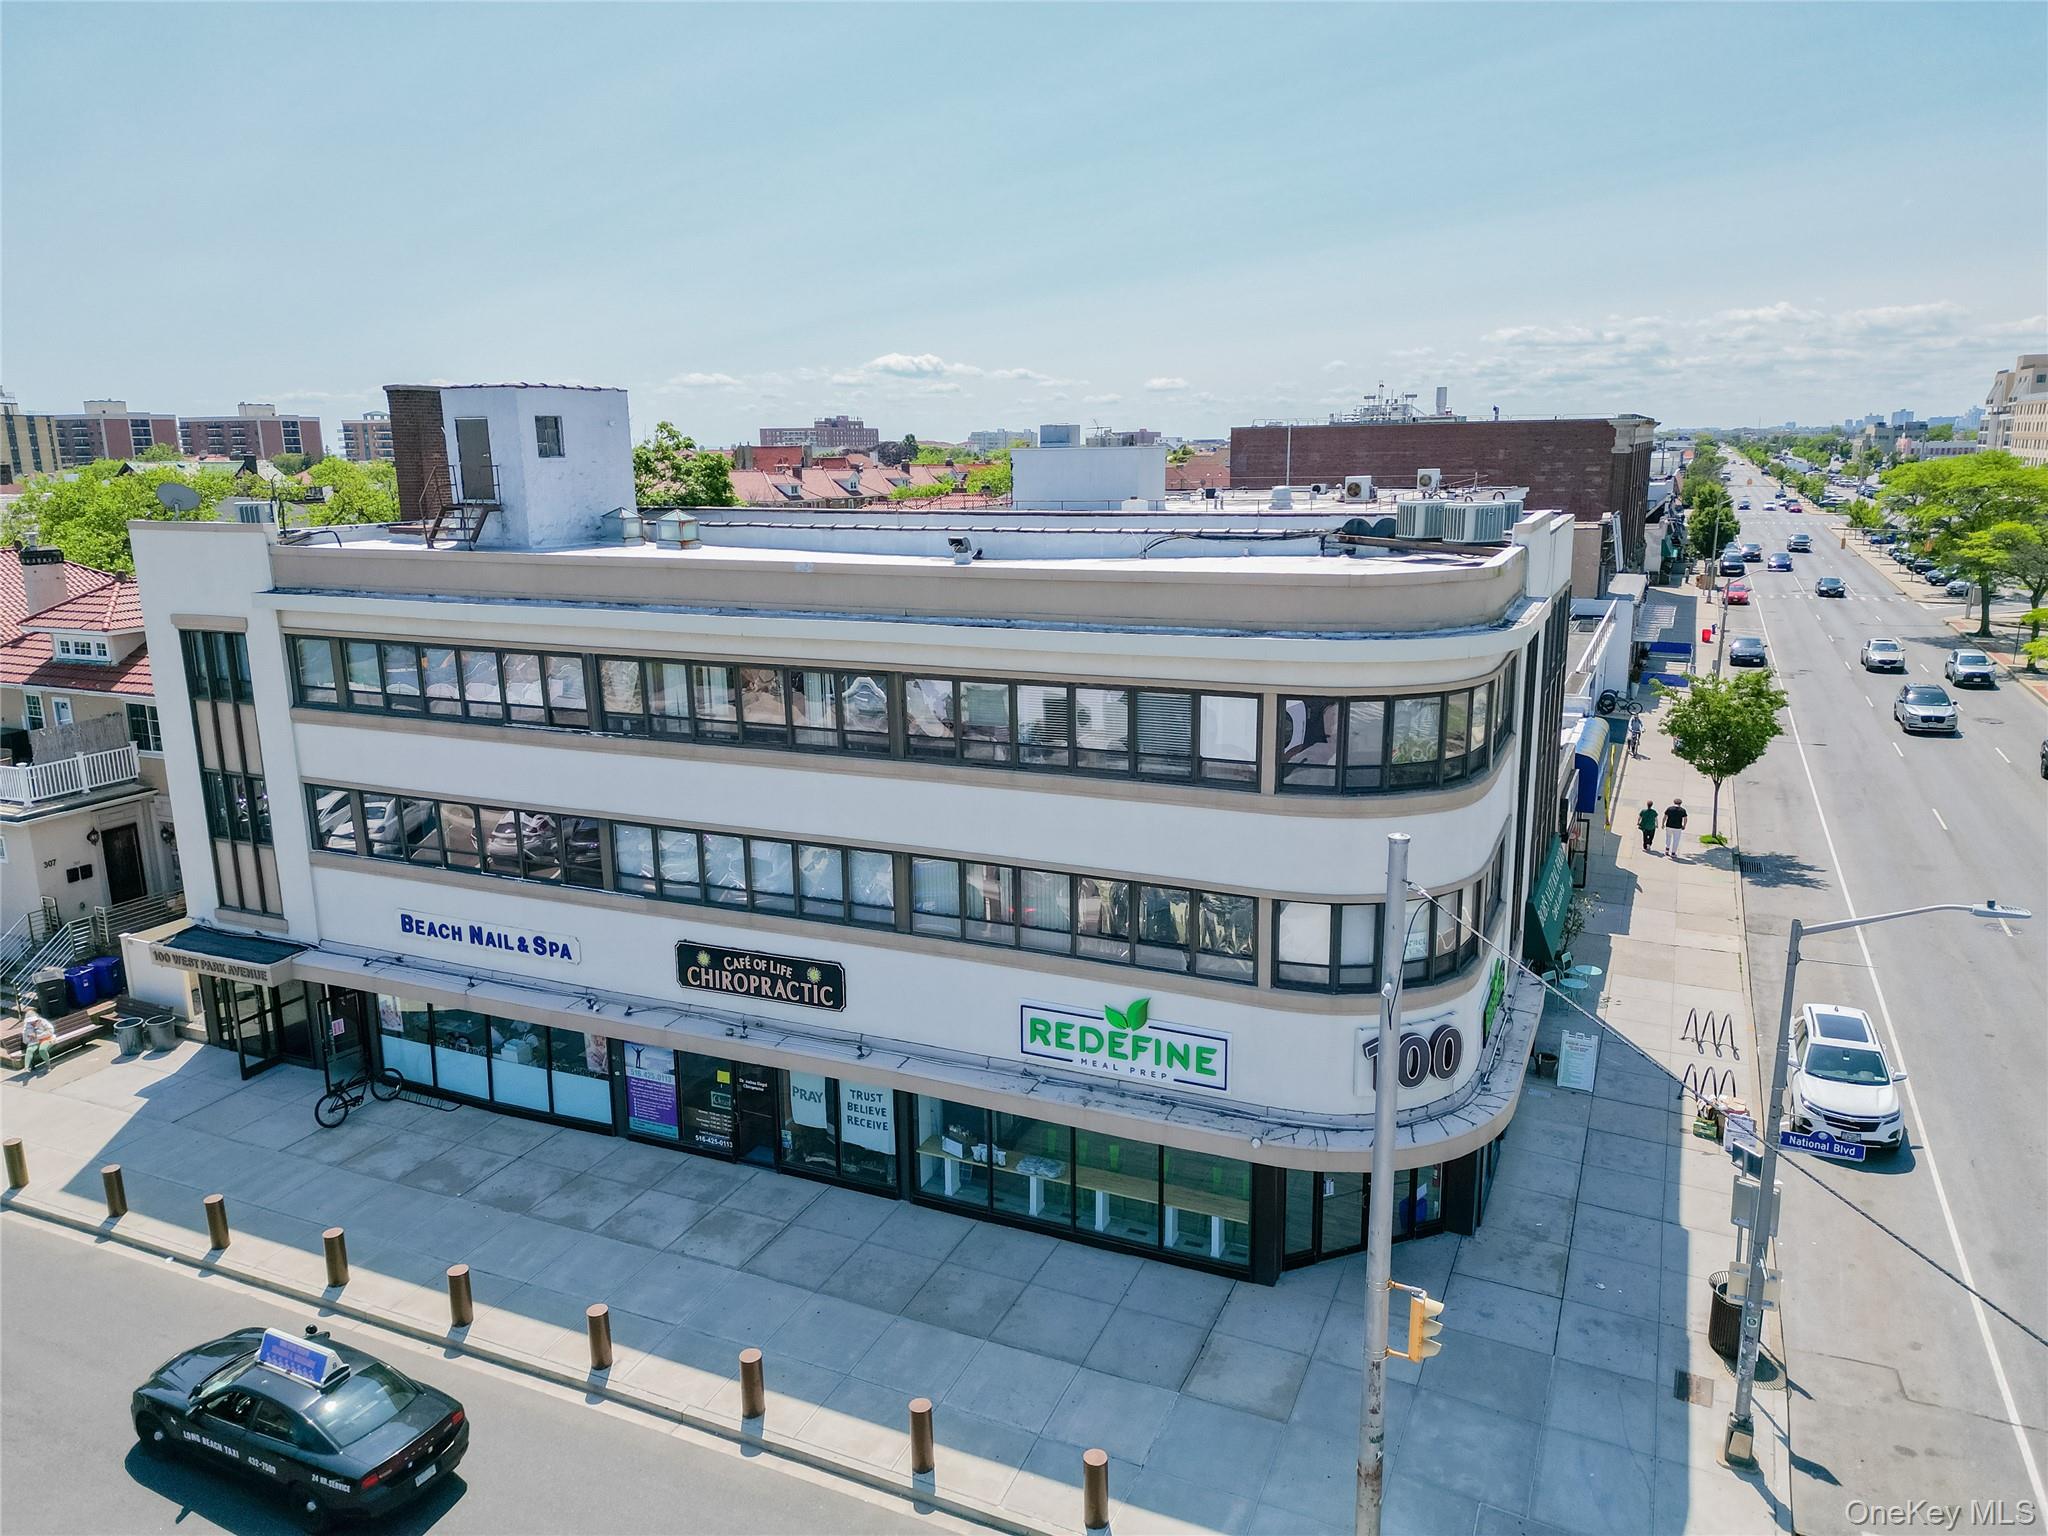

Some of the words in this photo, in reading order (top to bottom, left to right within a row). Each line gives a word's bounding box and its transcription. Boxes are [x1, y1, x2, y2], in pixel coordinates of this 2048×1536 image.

[43, 859, 56, 868] 307
[400, 913, 463, 942] BEACH
[469, 925, 514, 951] NAIL
[517, 936, 530, 953] &
[532, 936, 572, 960] SPA
[152, 951, 171, 963] 100
[172, 953, 199, 969] WEST
[200, 959, 227, 973] PARK
[228, 965, 268, 981] AVENUE
[723, 956, 751, 970] CAFÉ
[753, 958, 768, 971] OF
[769, 960, 793, 979] LIFE
[687, 966, 834, 1006] CHIROPRACTIC
[1029, 1017, 1218, 1077] REDEFINE
[1080, 1058, 1118, 1071] MEAL
[1129, 1067, 1168, 1080] PREP
[792, 1085, 824, 1103] PRAY
[849, 1089, 883, 1103] TRUST
[847, 1102, 887, 1117] BELIEVE
[847, 1115, 889, 1131] RECEIVE
[695, 1134, 733, 1148] 516-425-0113
[1789, 1135, 1830, 1151] National
[1833, 1143, 1856, 1156] Blvd
[183, 1430, 201, 1443] LONG
[202, 1436, 223, 1452] BEACH
[224, 1445, 240, 1459] TAXI
[311, 1473, 319, 1482] 24
